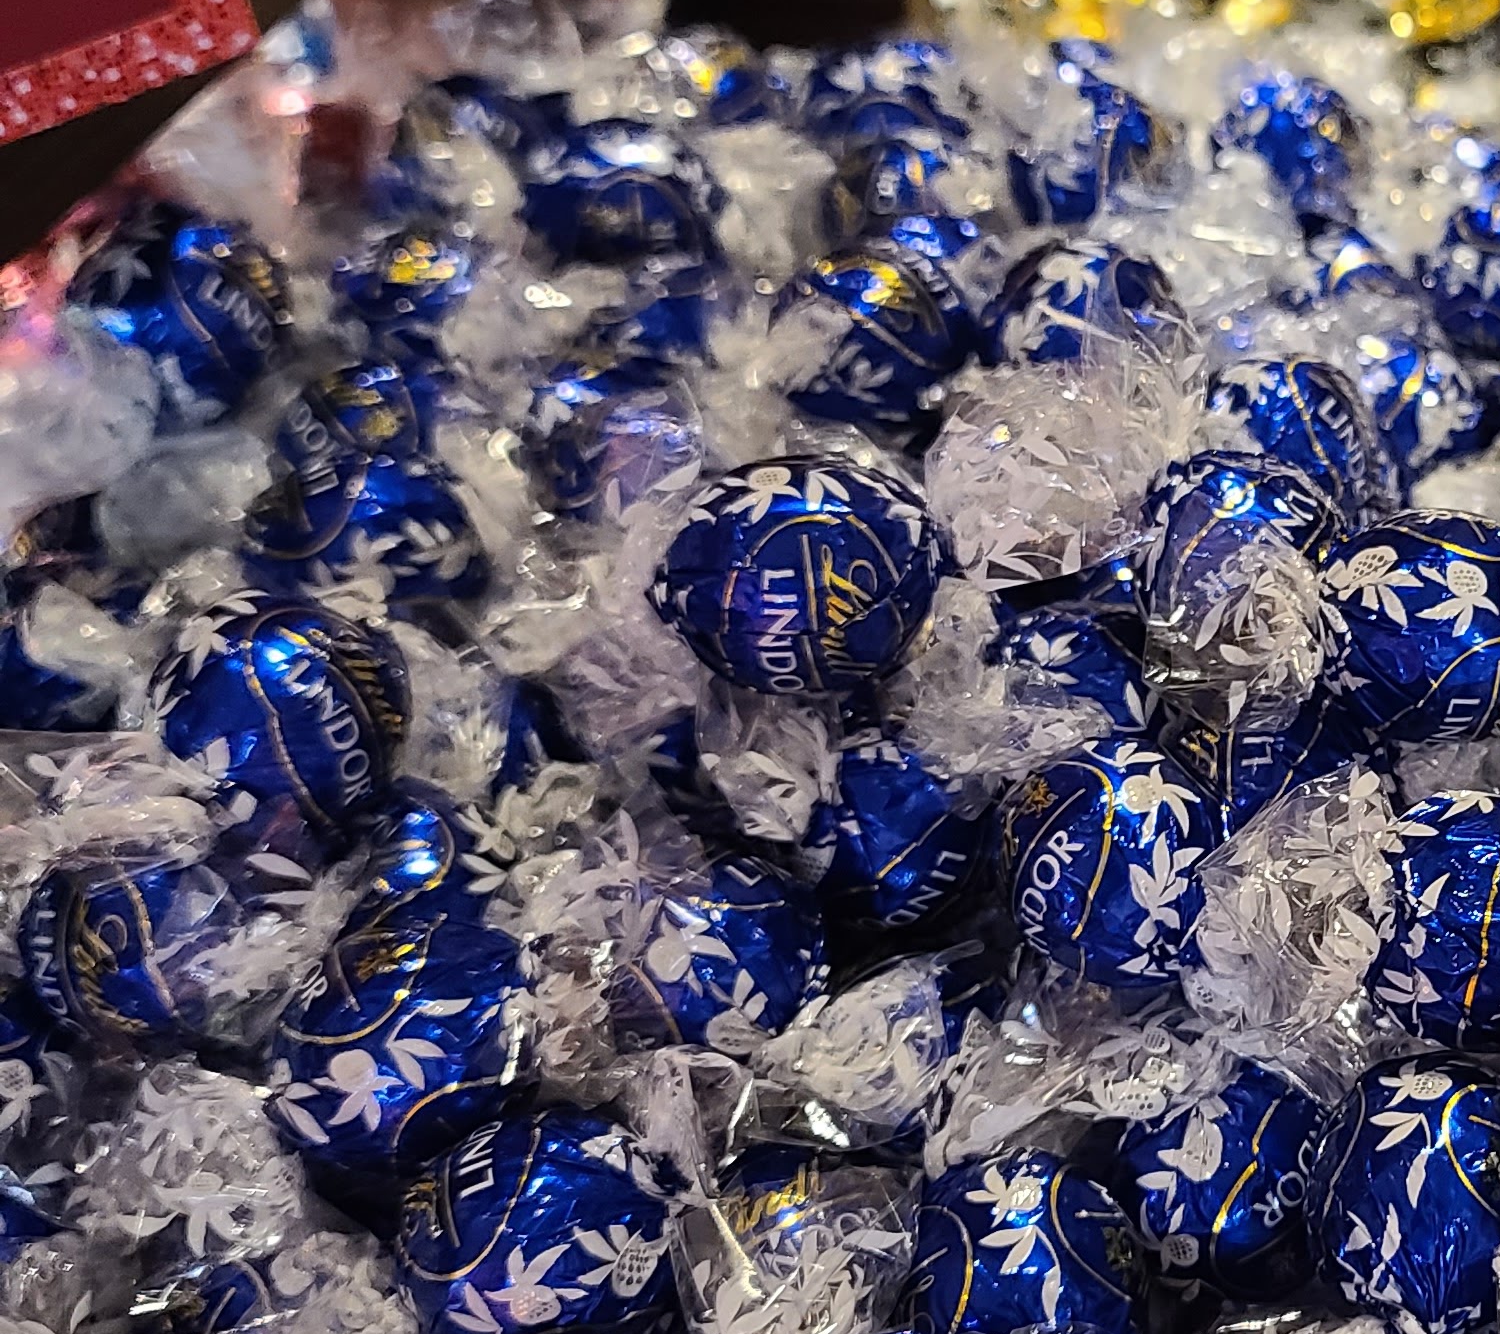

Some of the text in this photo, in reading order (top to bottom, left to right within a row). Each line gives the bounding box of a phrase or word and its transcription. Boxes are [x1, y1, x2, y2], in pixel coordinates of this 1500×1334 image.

[203, 275, 273, 351] LIND
[757, 567, 807, 695] LINDO
[1436, 696, 1482, 742] LIN
[885, 848, 968, 928] LIND
[32, 909, 71, 1017] LIND
[458, 1119, 503, 1200] LIND
